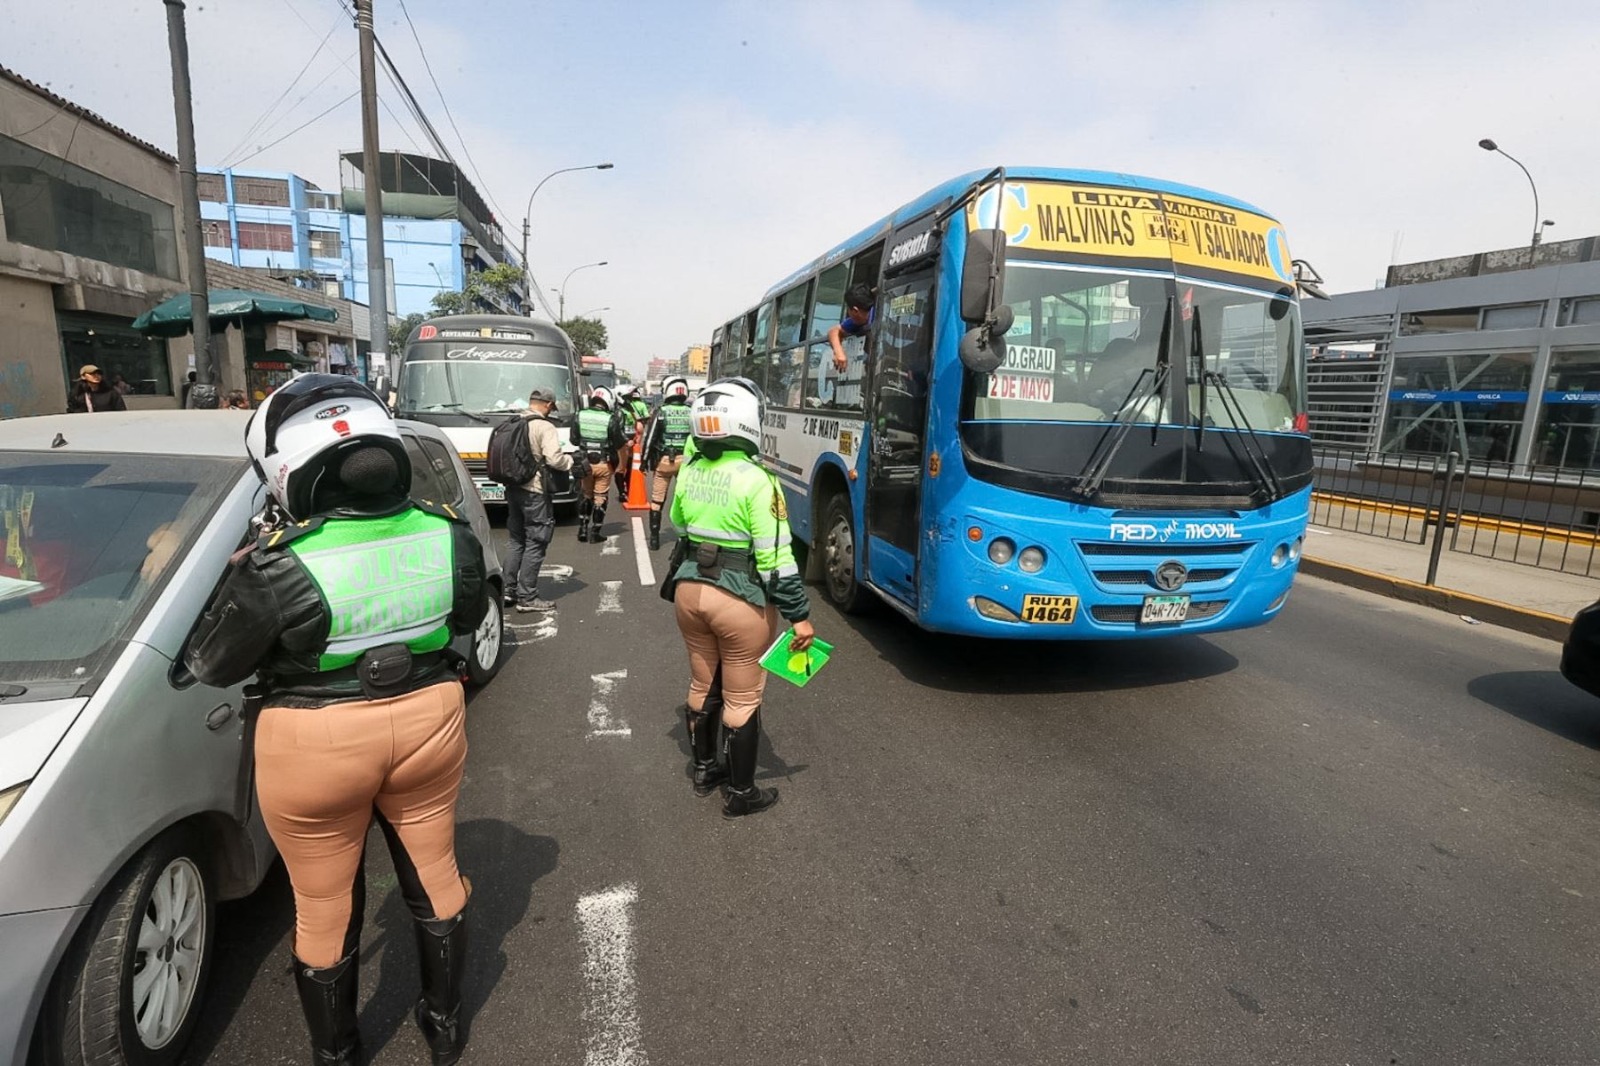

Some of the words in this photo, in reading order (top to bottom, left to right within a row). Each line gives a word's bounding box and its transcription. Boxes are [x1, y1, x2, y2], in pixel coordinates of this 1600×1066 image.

[978, 184, 1030, 246] C
[1077, 191, 1157, 210] LIMA
[1163, 200, 1222, 222] V.MARIA
[1223, 212, 1236, 225] T.
[1037, 204, 1135, 247] MALVINAS
[1153, 215, 1179, 227] RUTA
[1149, 223, 1188, 243] 1464
[1190, 219, 1270, 268] V.SALVADOR
[889, 229, 931, 266] SUBIDA
[990, 374, 998, 396] 2
[1001, 375, 1016, 398] DE
[1020, 377, 1051, 400] MAYO
[697, 405, 728, 413] TRANSITO
[803, 417, 809, 434] 2
[809, 418, 818, 436] DE
[818, 419, 839, 440] MAYO
[686, 467, 731, 489] POLICIA
[685, 484, 729, 507] TRANSITO
[1110, 523, 1157, 541] RED
[322, 540, 448, 595] POLICIA
[334, 582, 451, 636] TRANSITO
[1030, 596, 1071, 606] RUTA
[1025, 607, 1072, 621] 1464
